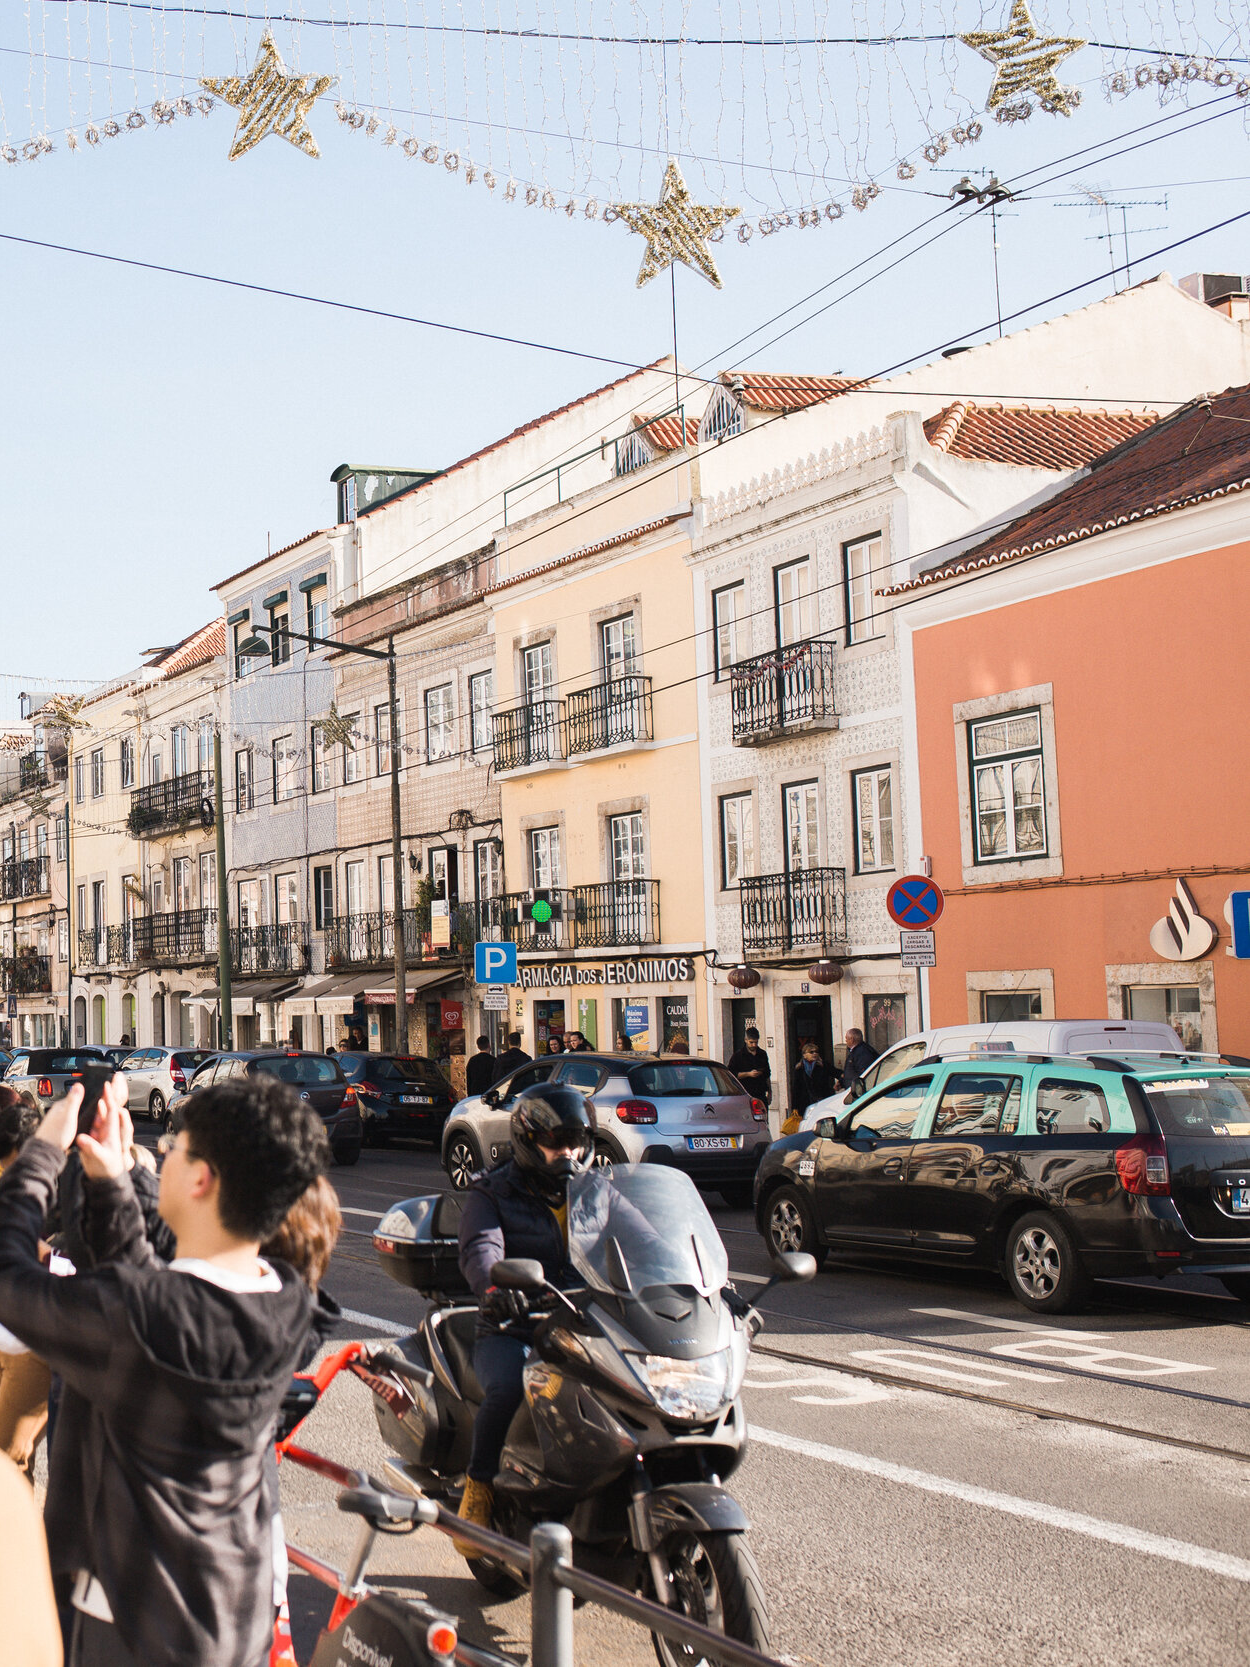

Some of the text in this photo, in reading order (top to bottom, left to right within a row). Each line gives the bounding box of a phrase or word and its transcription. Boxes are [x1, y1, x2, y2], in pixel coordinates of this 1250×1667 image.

[485, 947, 507, 979] P
[514, 957, 688, 987] ARMÁCIA DOS JERÓNIMOS
[883, 998, 891, 1007] 99
